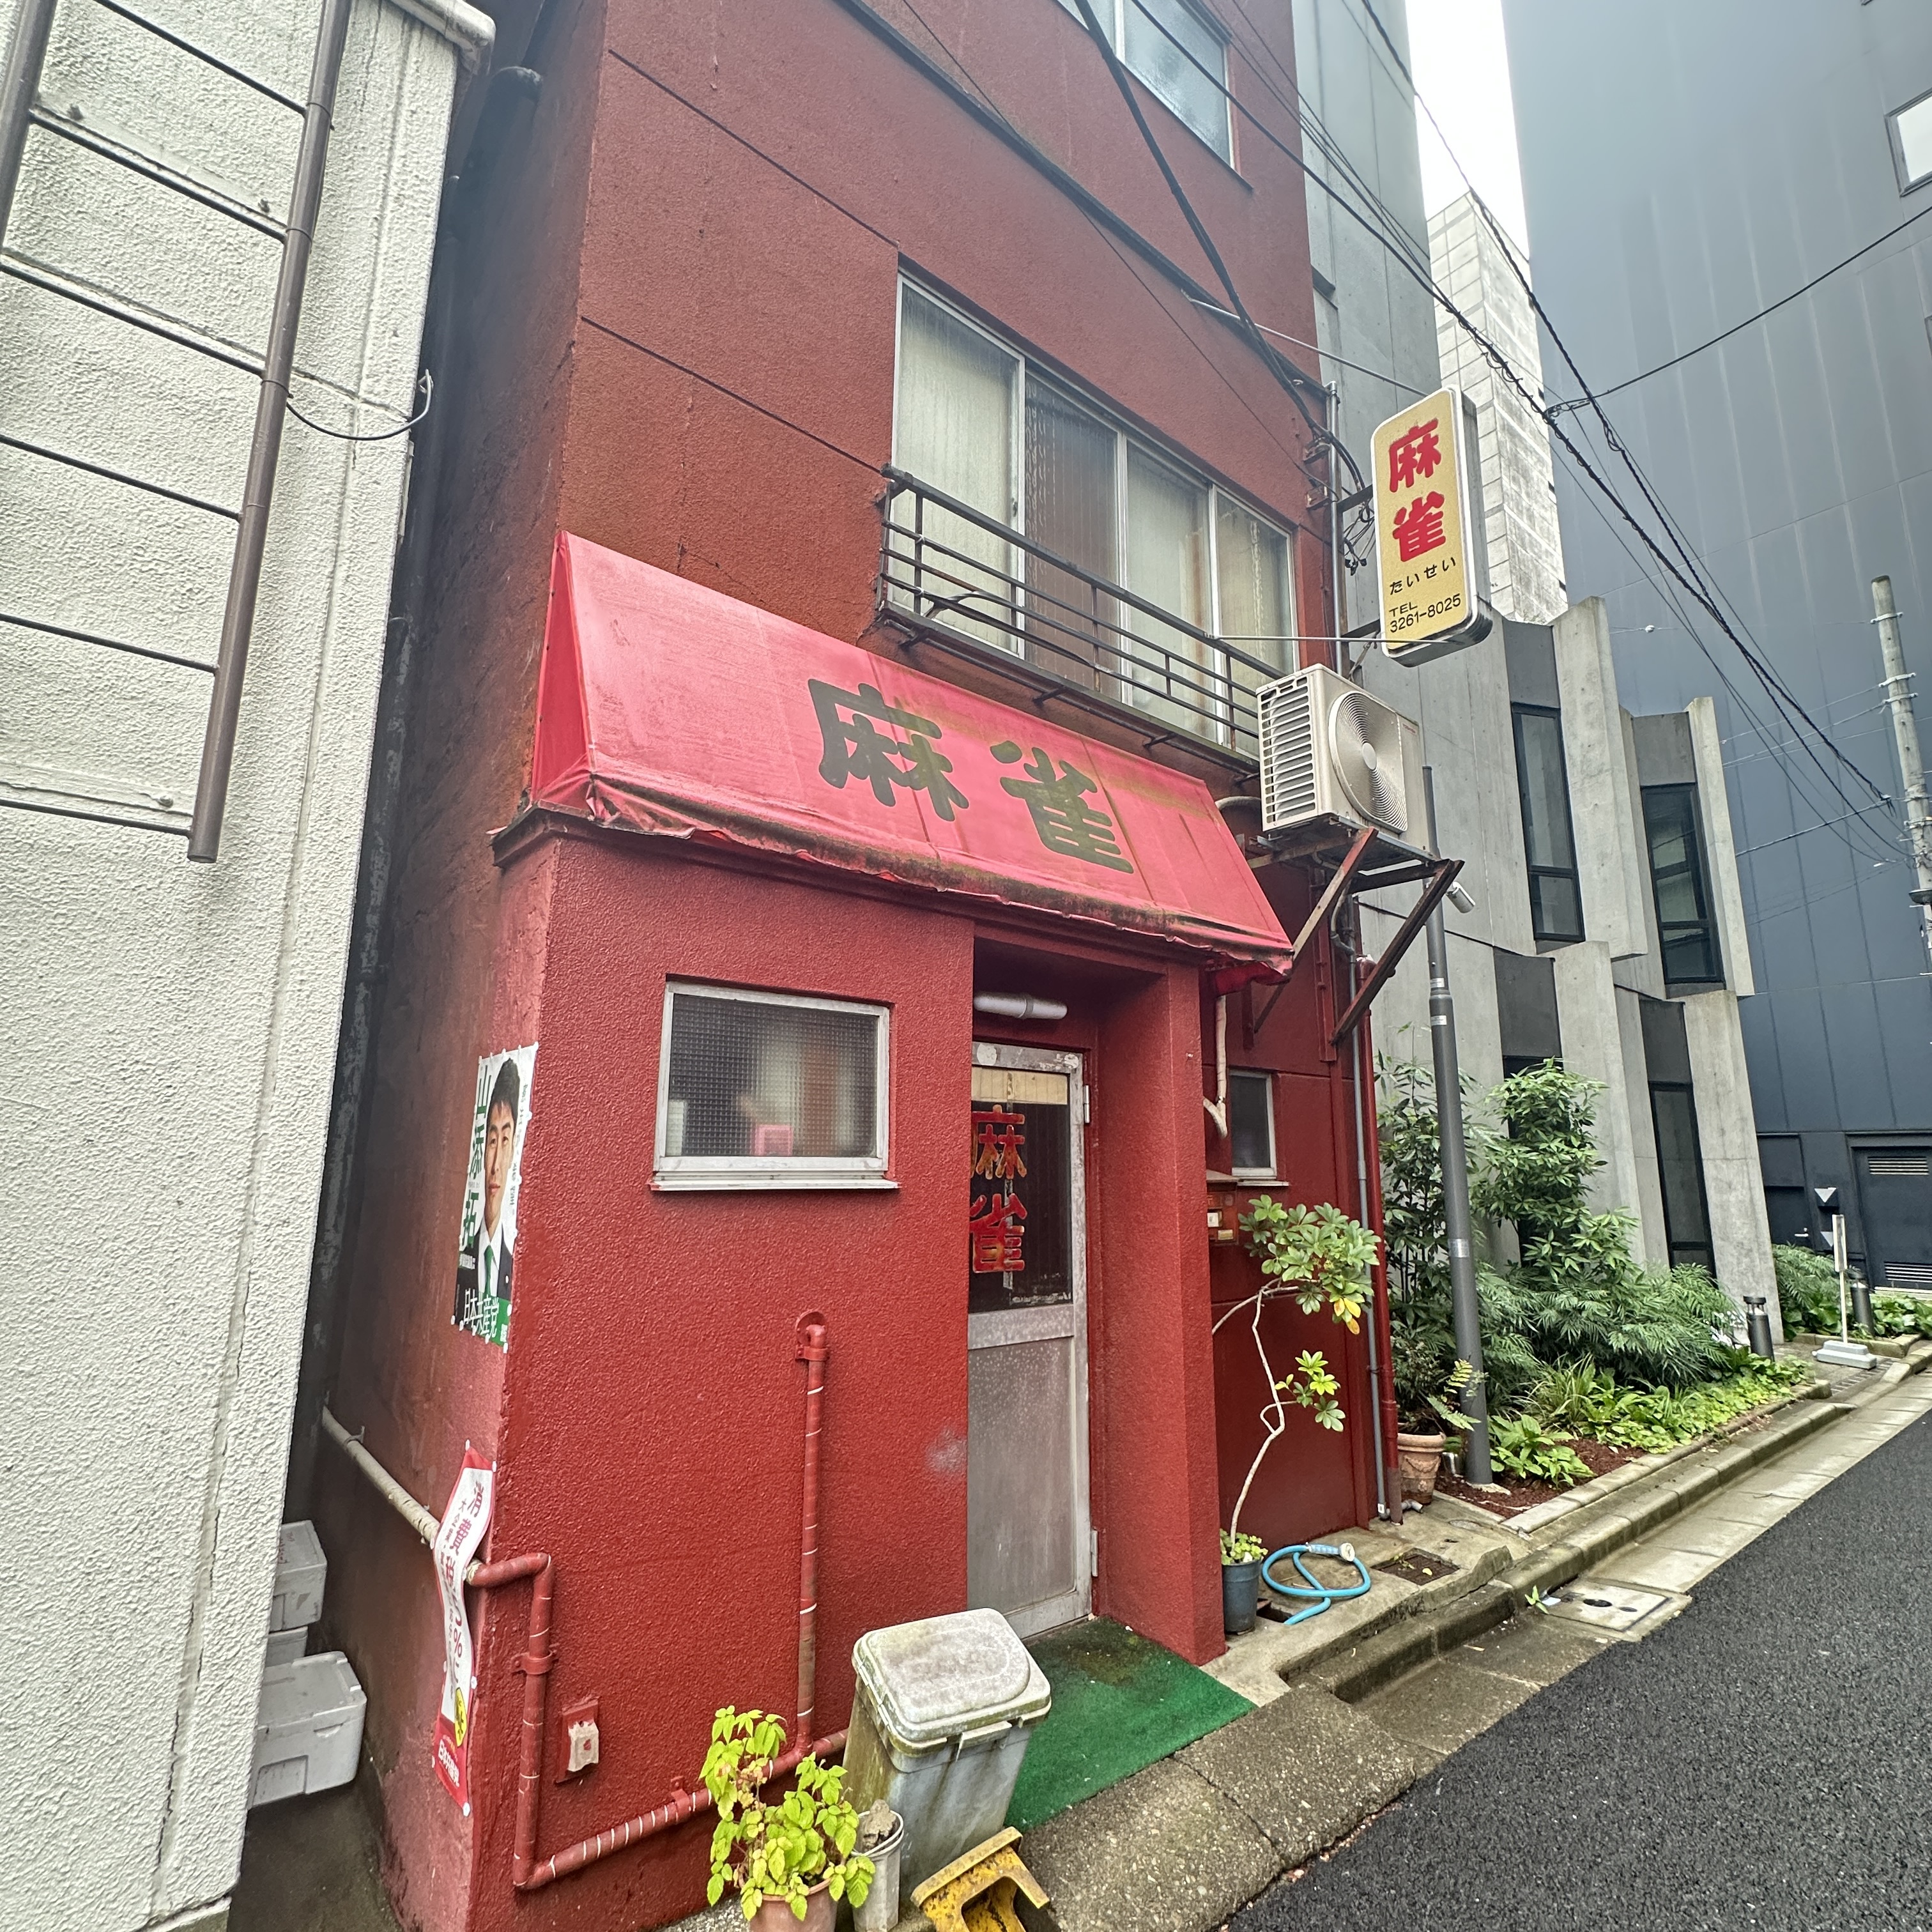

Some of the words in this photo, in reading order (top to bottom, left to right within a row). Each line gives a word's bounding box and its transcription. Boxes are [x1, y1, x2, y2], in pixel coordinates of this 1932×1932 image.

[1388, 417, 1446, 563] 麻雀
[1388, 602, 1418, 618] TEL
[1389, 556, 1457, 595] たいせい
[1390, 593, 1461, 633] 3261-8025
[808, 678, 1135, 875] 麻雀
[461, 1064, 492, 1251] 山添拓
[970, 1103, 1028, 1274] 麻雀
[463, 1288, 500, 1340] 日本共産党
